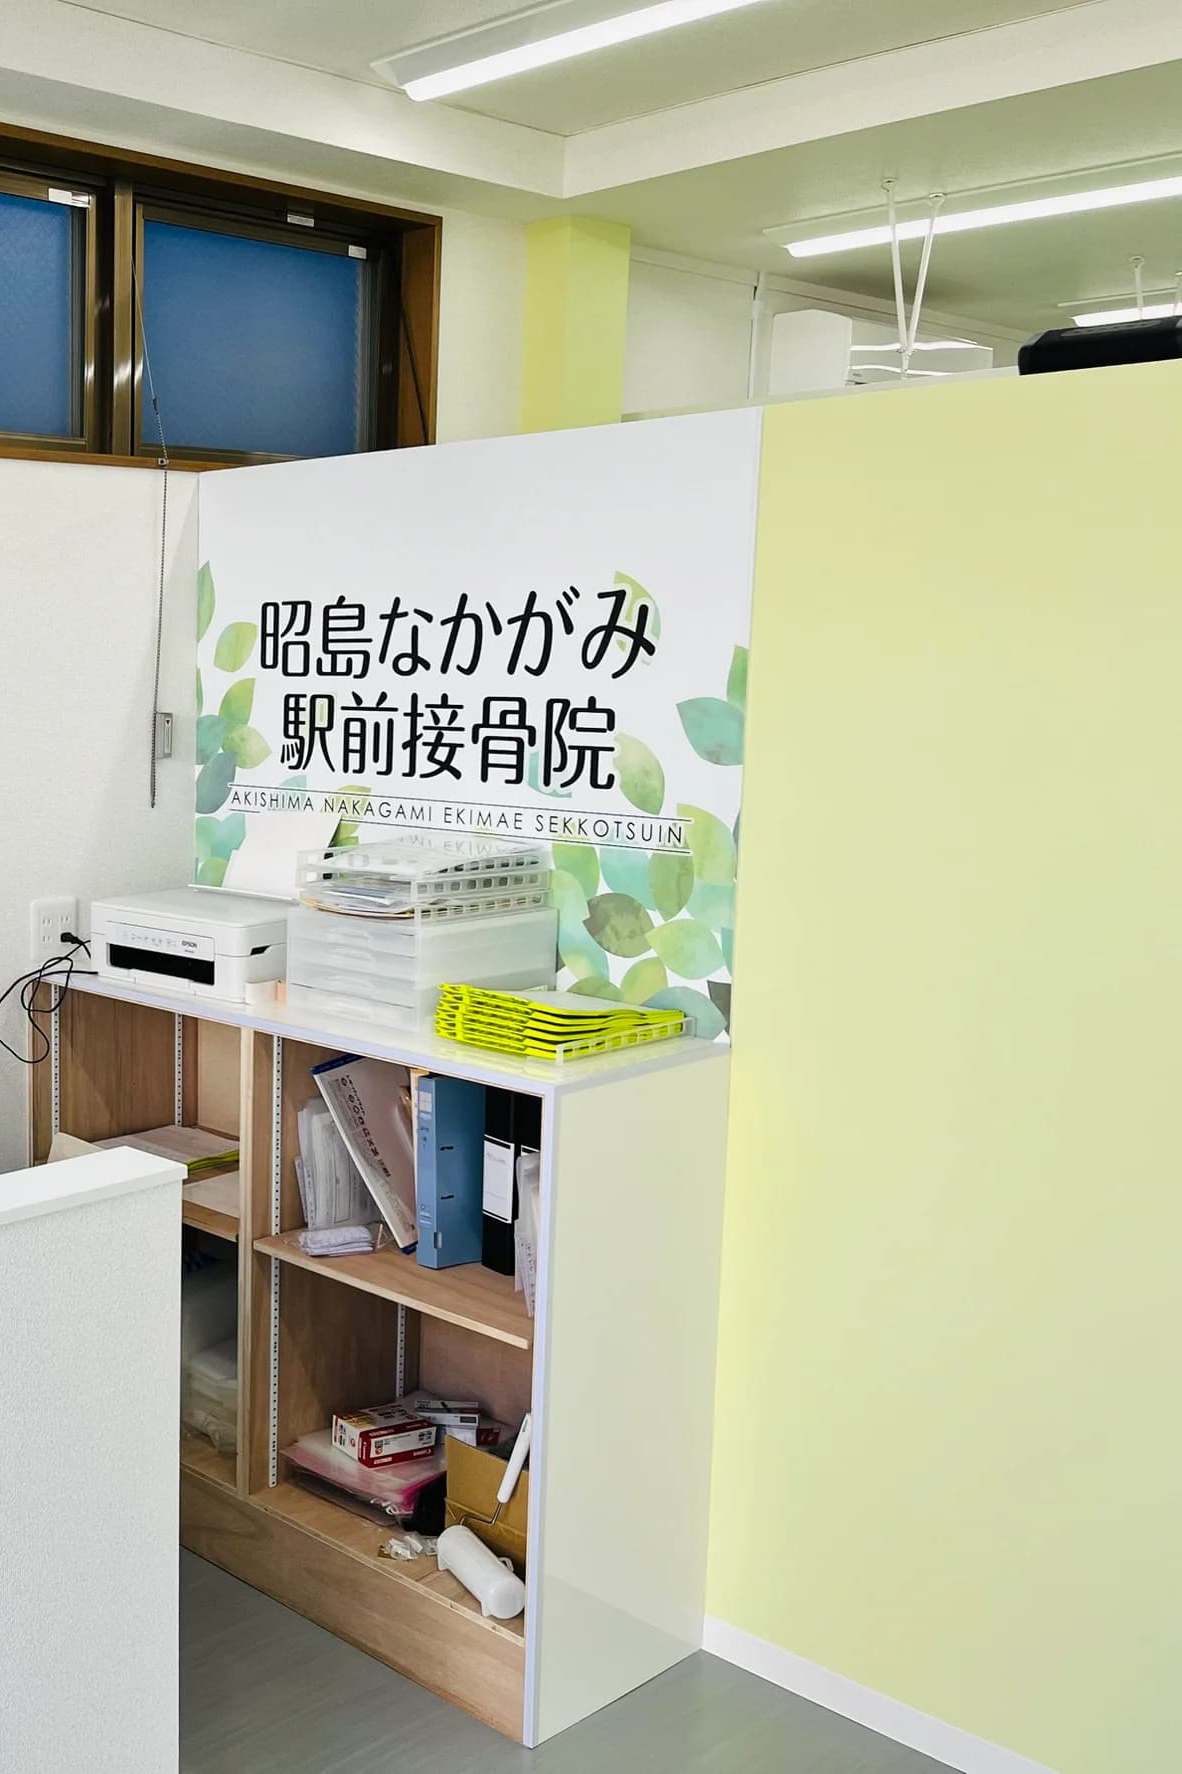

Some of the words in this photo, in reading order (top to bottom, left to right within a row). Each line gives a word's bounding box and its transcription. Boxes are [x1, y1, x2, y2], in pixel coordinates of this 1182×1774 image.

[260, 585, 656, 679] 昭島なかがみ
[280, 691, 616, 790] 駅前接骨院
[231, 791, 314, 811] AKISHIMA
[324, 797, 432, 822] NAKAGAMI
[443, 807, 523, 830] EKIMAE
[535, 814, 683, 845] SEKKOTSUIN
